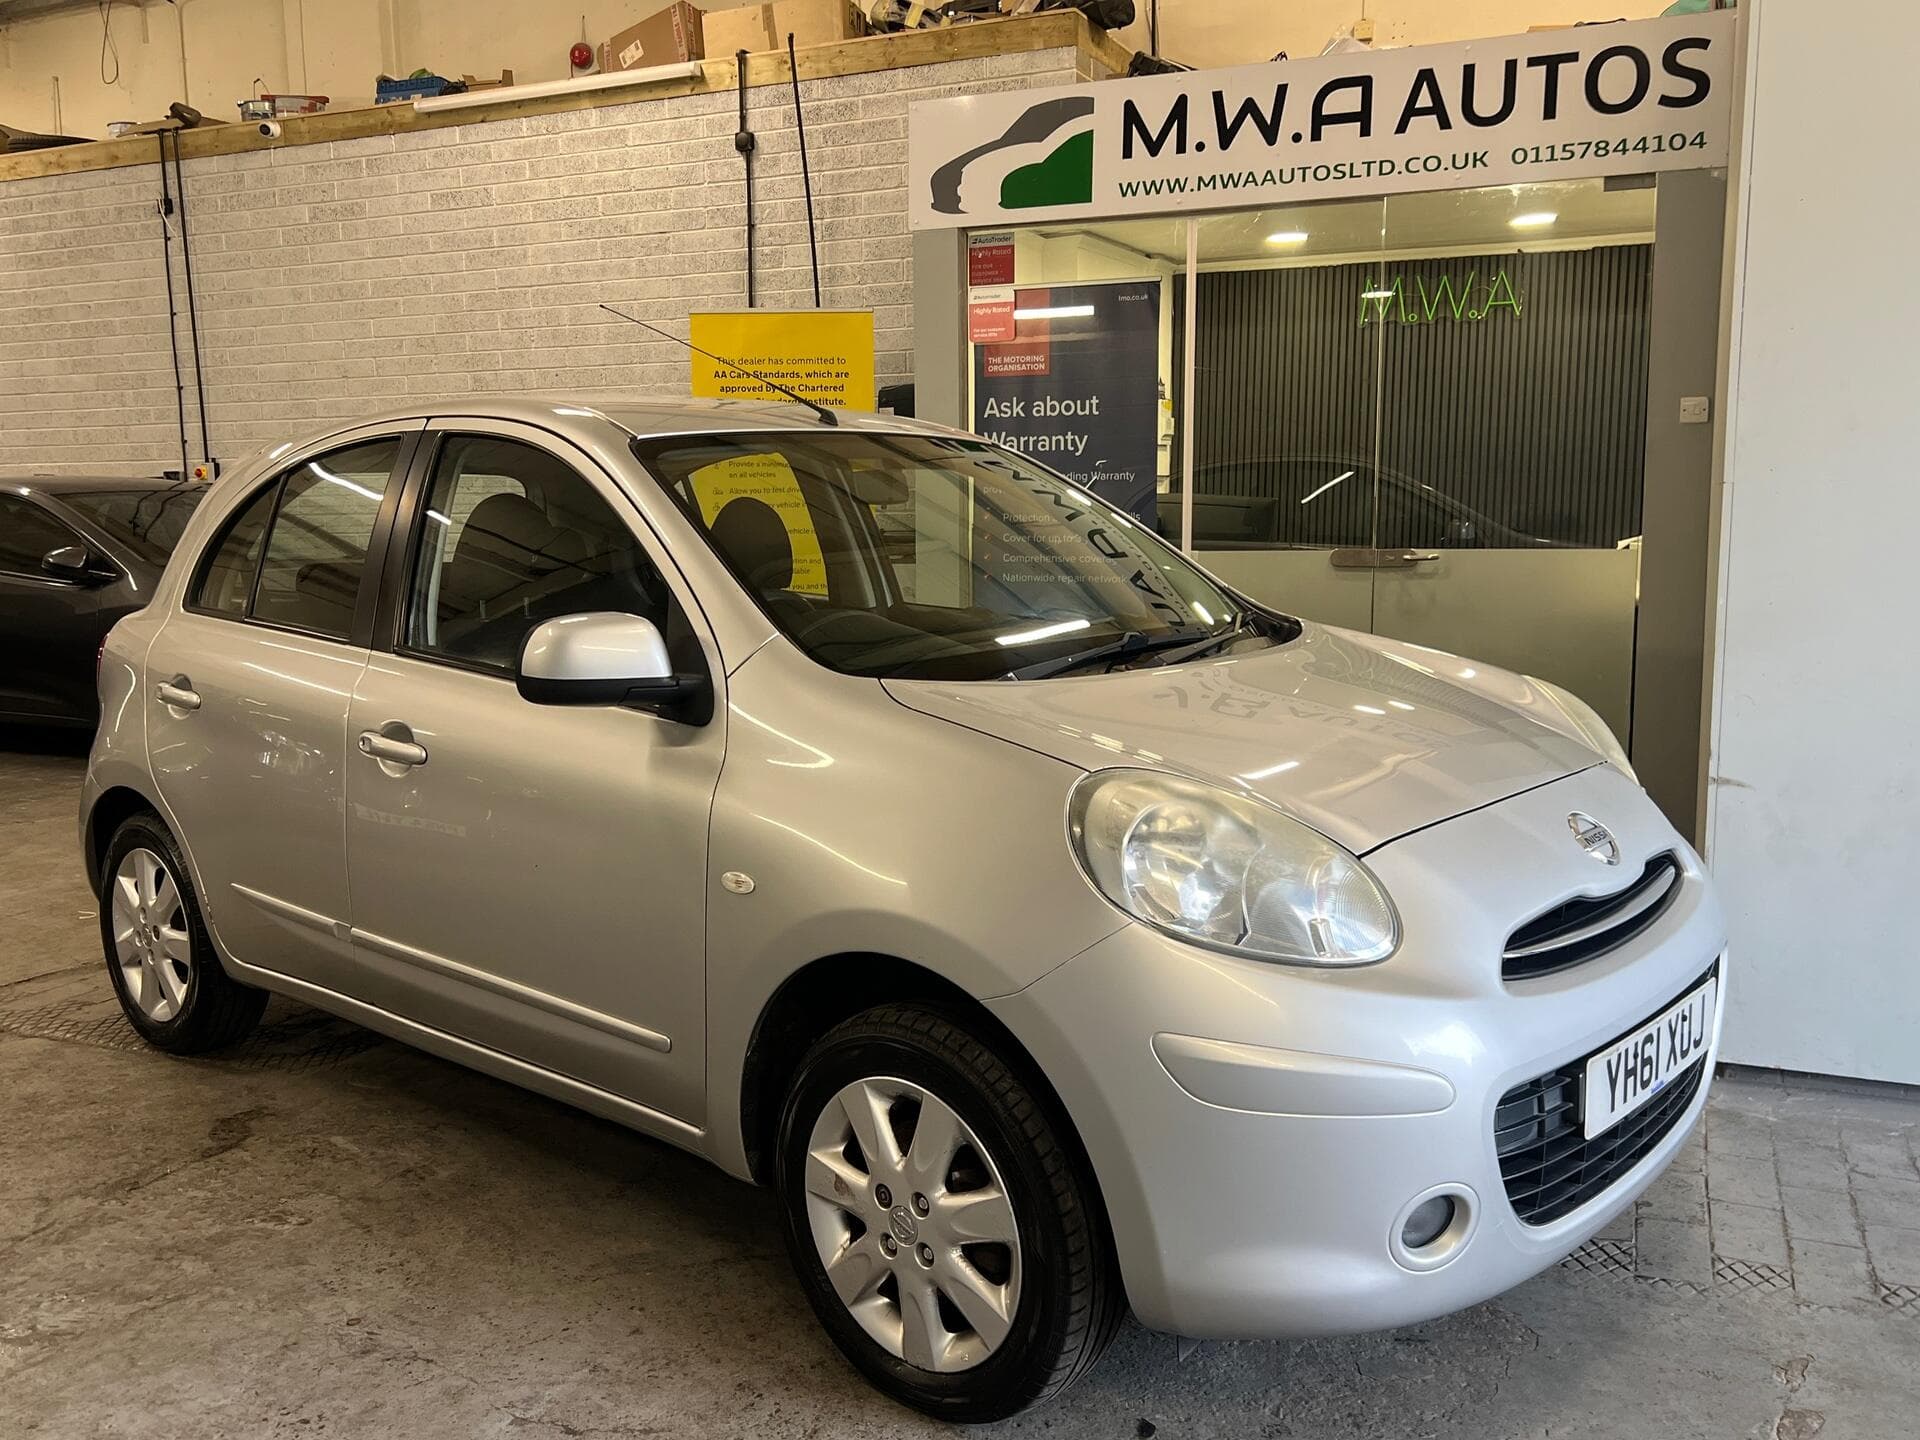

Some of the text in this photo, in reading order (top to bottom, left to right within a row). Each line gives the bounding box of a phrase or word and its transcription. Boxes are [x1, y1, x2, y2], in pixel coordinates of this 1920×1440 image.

[1122, 37, 1712, 160] M.W.A AUTOS
[1119, 131, 1708, 198] WWW.MWAAUTOSLTD.CO.UK 01157844104
[738, 357, 766, 366] dealer
[768, 357, 784, 365] has
[786, 357, 835, 365] committed
[837, 357, 847, 365] to
[1003, 355, 1045, 363] MOTORING
[988, 363, 1046, 372] ORGANISATION
[714, 371, 728, 379] AA
[729, 371, 750, 379] Cars
[752, 370, 803, 380] Standards,
[805, 370, 833, 379] which
[720, 384, 763, 393] approved
[765, 383, 777, 393] by
[798, 383, 845, 392] Chartered
[984, 395, 1100, 418] Ask about
[1090, 471, 1136, 482] Warranty
[1003, 513, 1050, 522] Protection
[1003, 533, 1030, 543] Cover
[1033, 533, 1046, 542] for
[1003, 553, 1076, 563] Comprehensive
[1003, 573, 1127, 584] Nationwide repair network
[1607, 994, 1706, 1114] YH61 XUJ
